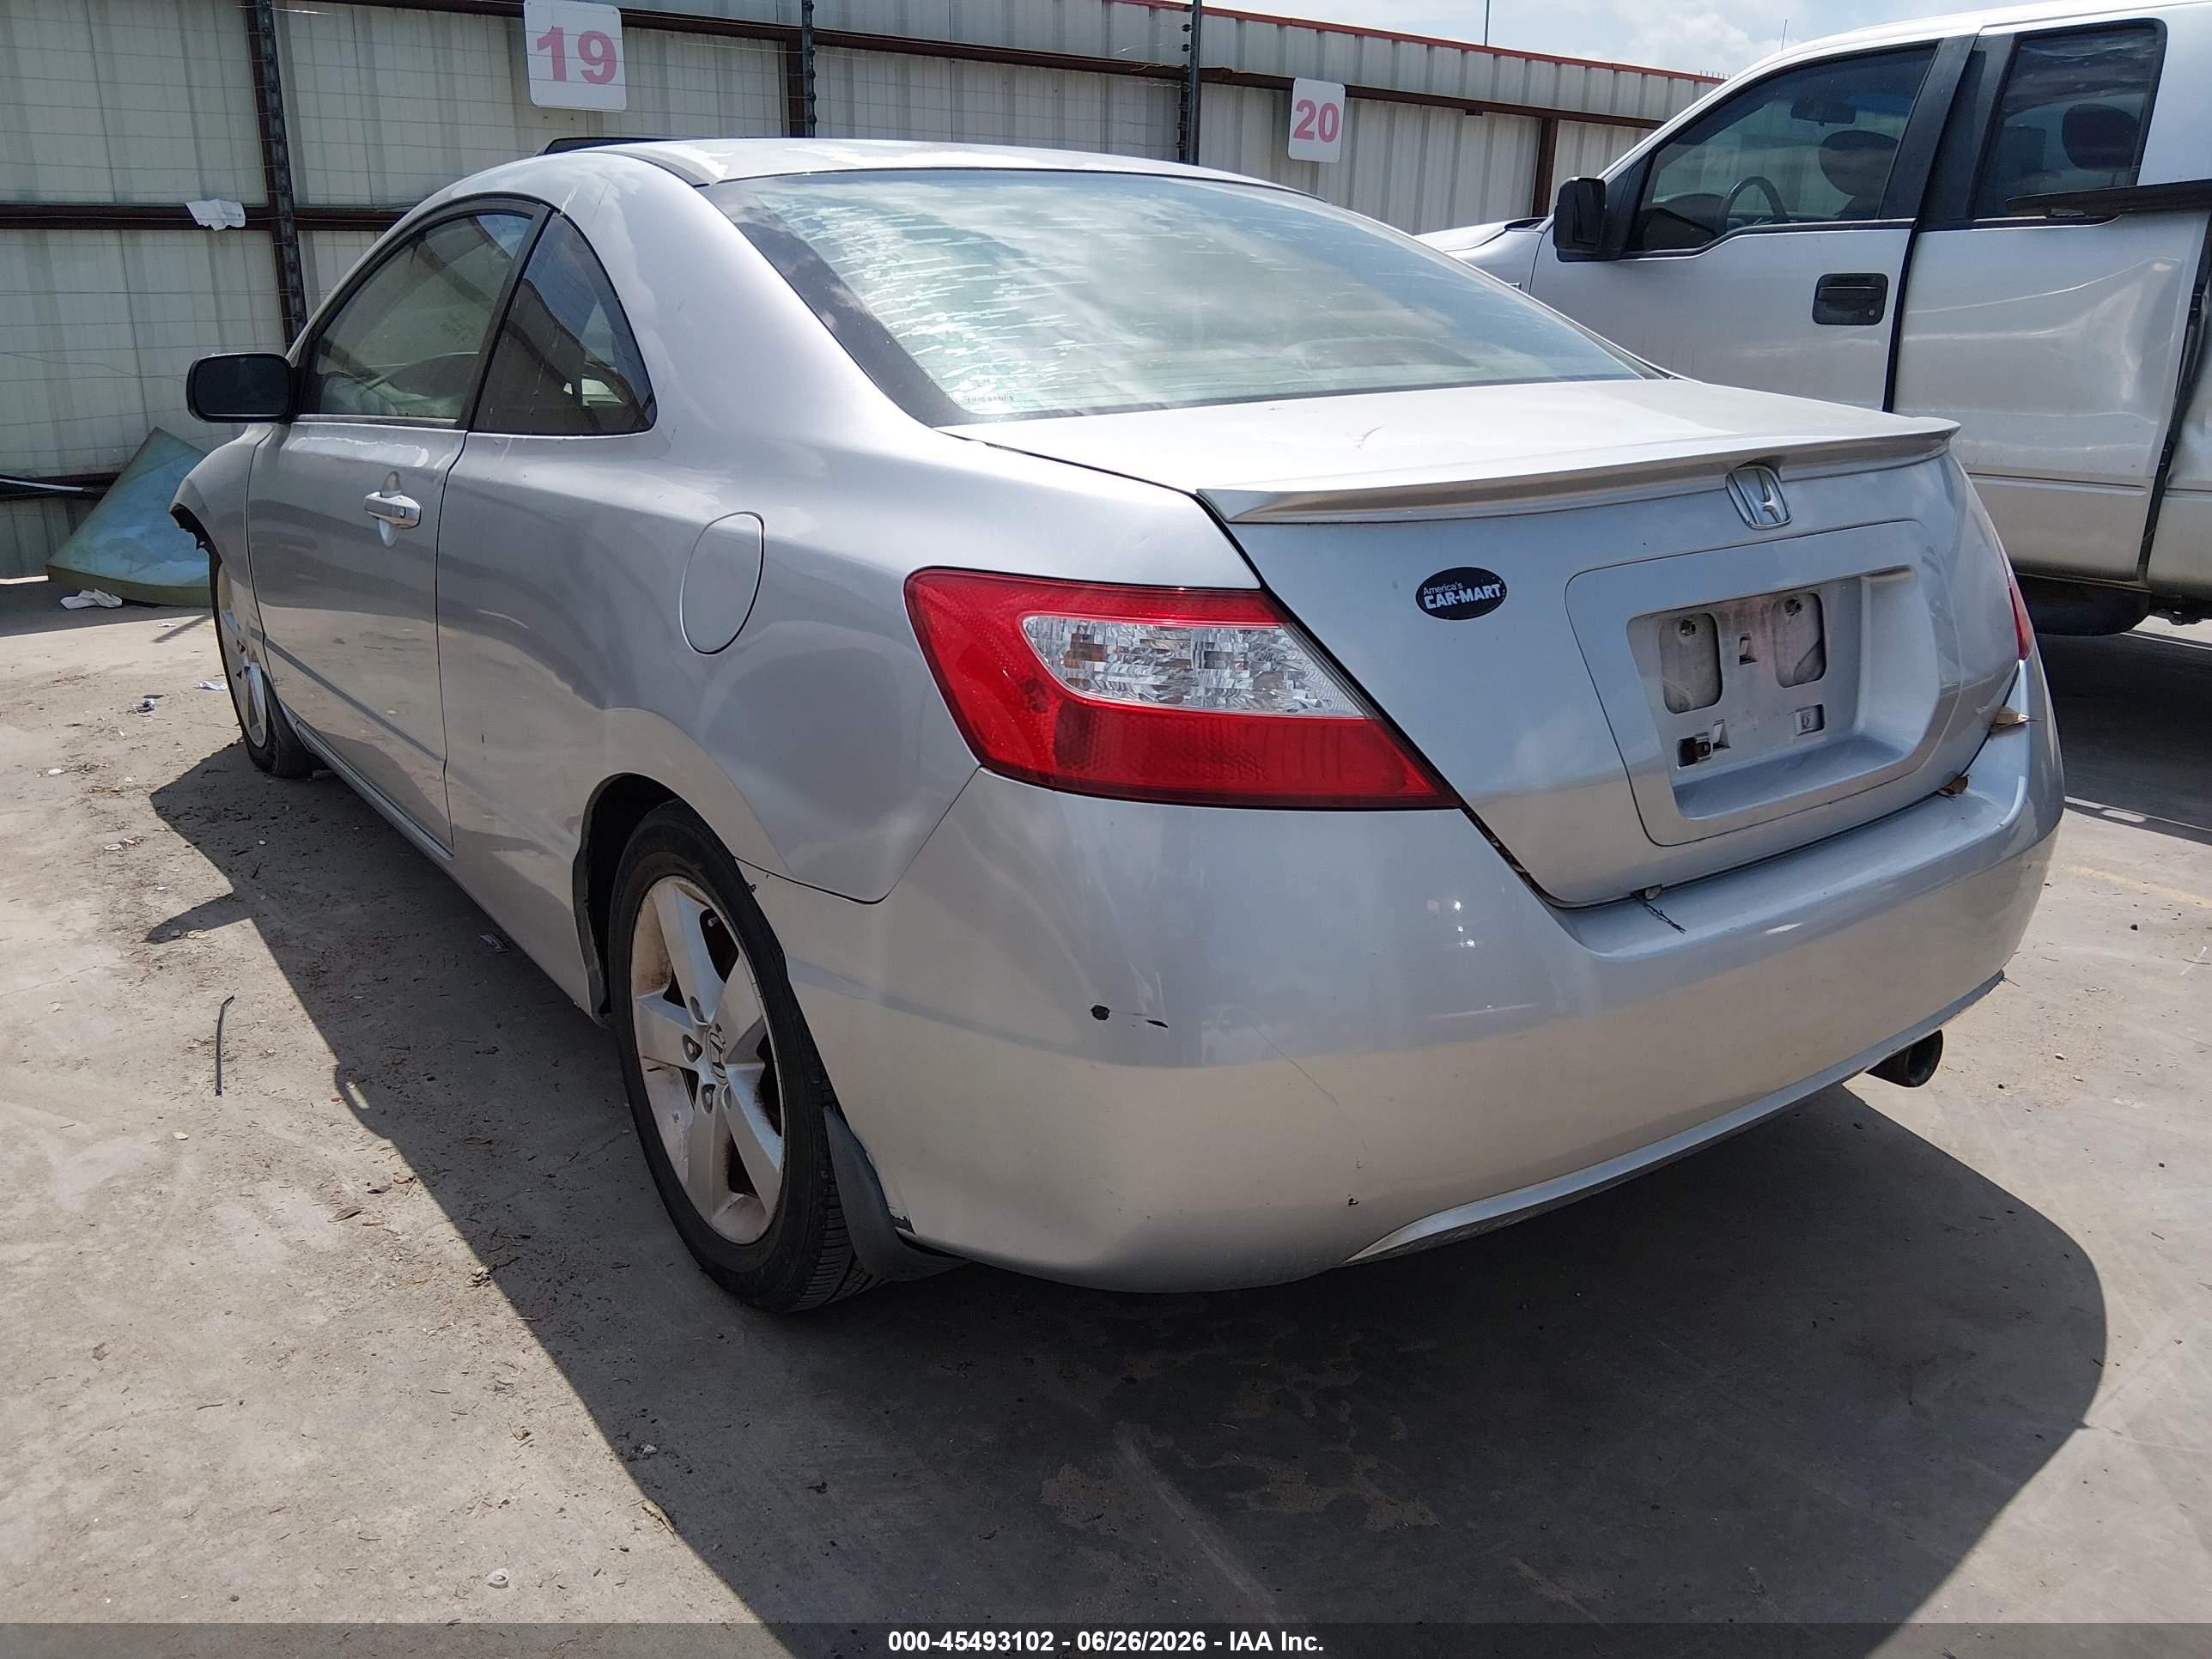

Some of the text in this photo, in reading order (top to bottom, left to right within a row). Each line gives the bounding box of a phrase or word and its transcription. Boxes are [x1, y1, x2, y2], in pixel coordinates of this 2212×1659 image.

[537, 27, 617, 84] 19
[1293, 99, 1340, 143] 20
[1423, 581, 1463, 596] America's
[1424, 584, 1501, 610] CAR-MART
